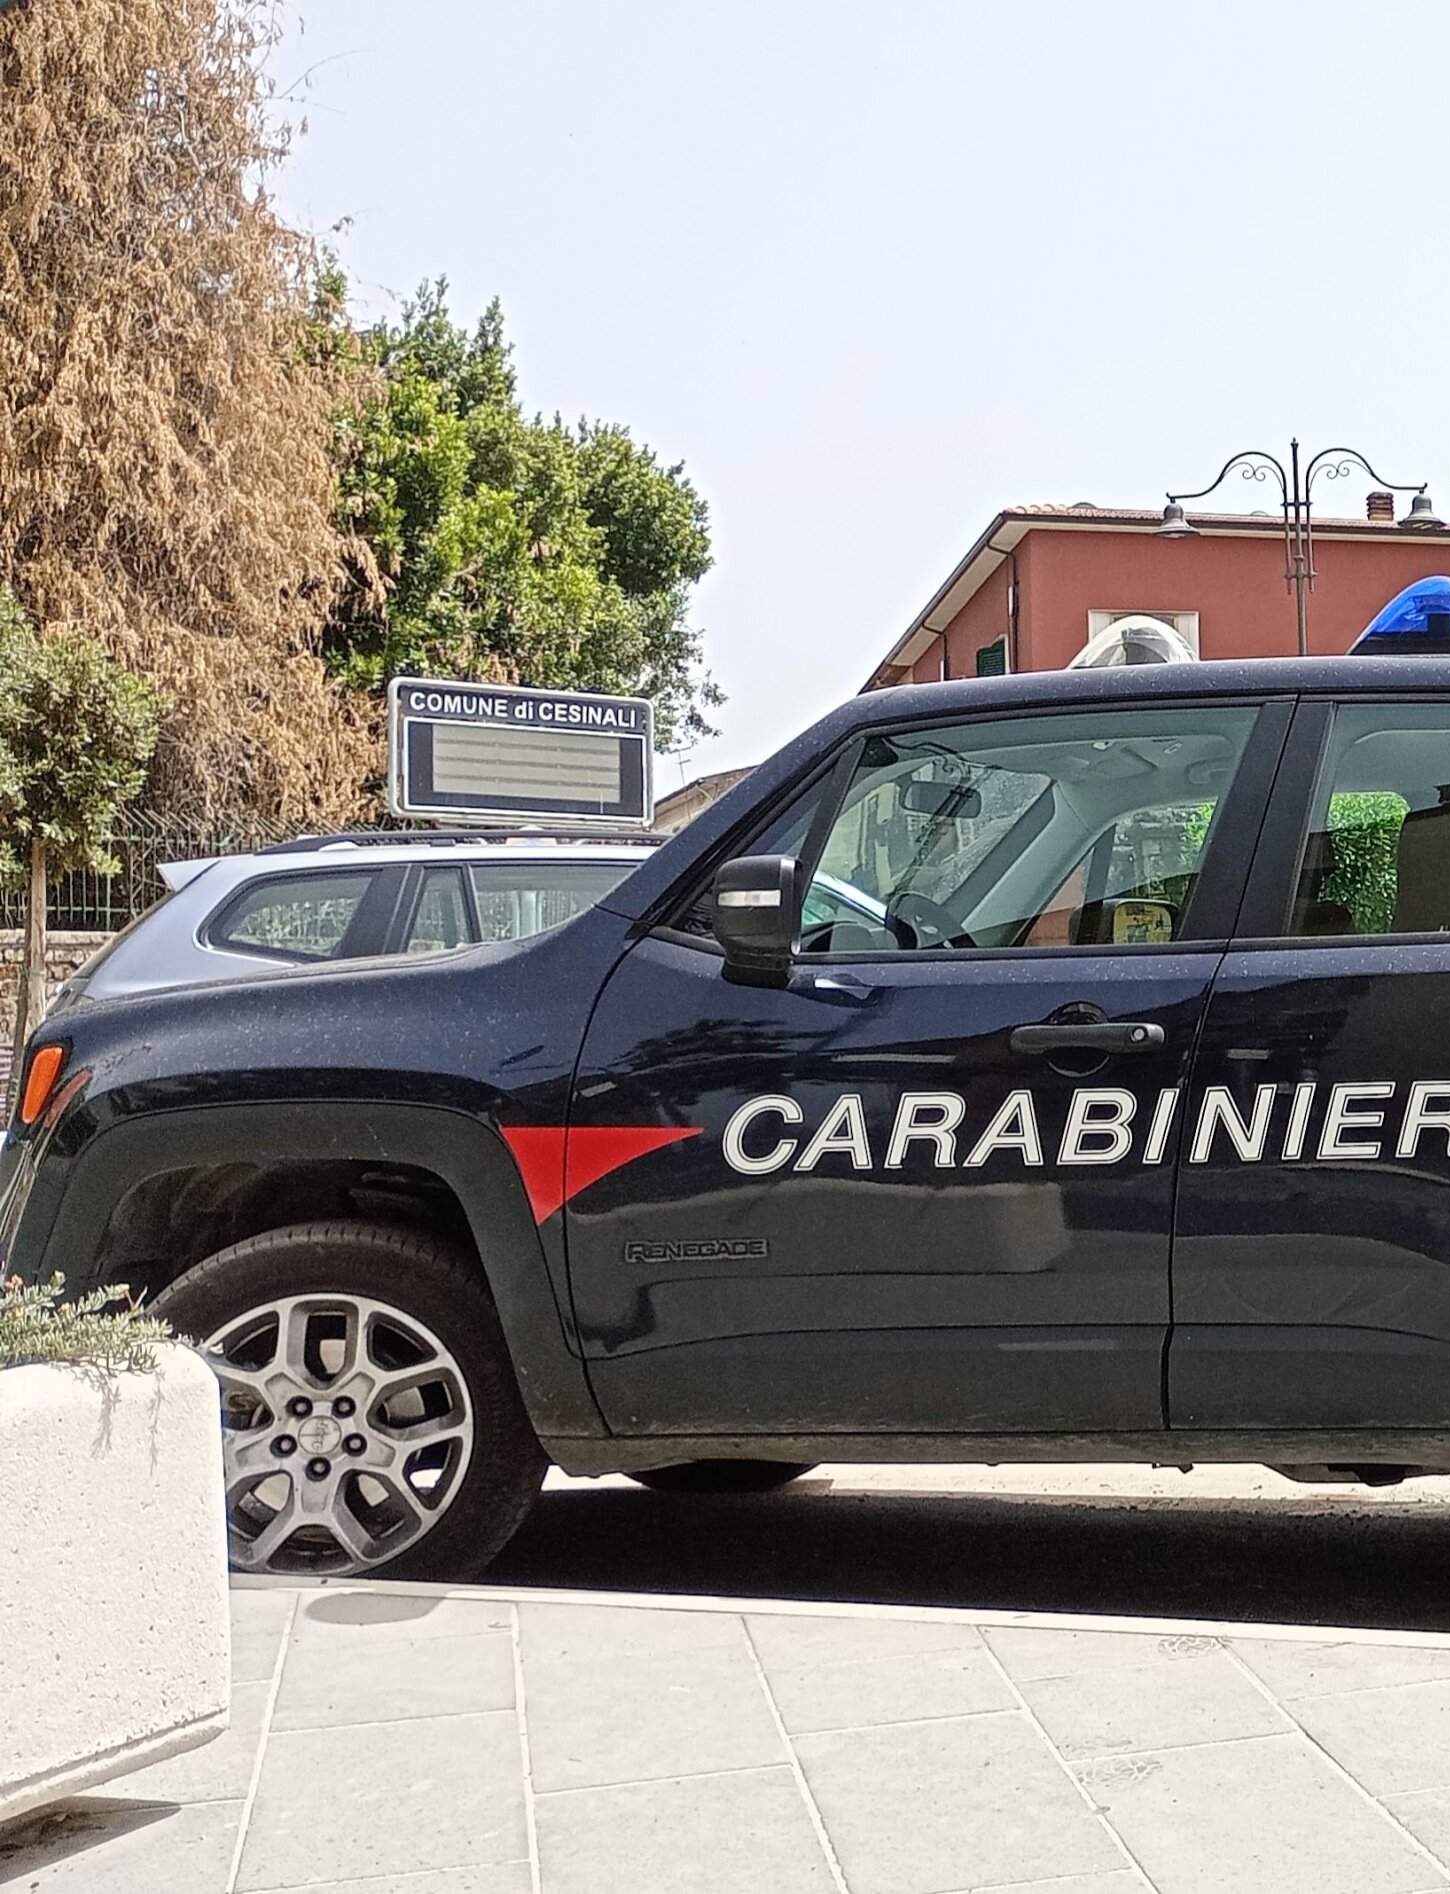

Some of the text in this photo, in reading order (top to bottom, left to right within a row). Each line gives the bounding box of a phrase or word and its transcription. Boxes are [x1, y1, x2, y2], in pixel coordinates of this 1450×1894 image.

[409, 691, 636, 728] COMUNE di CESINALI
[625, 1239, 769, 1262] RENEGADE
